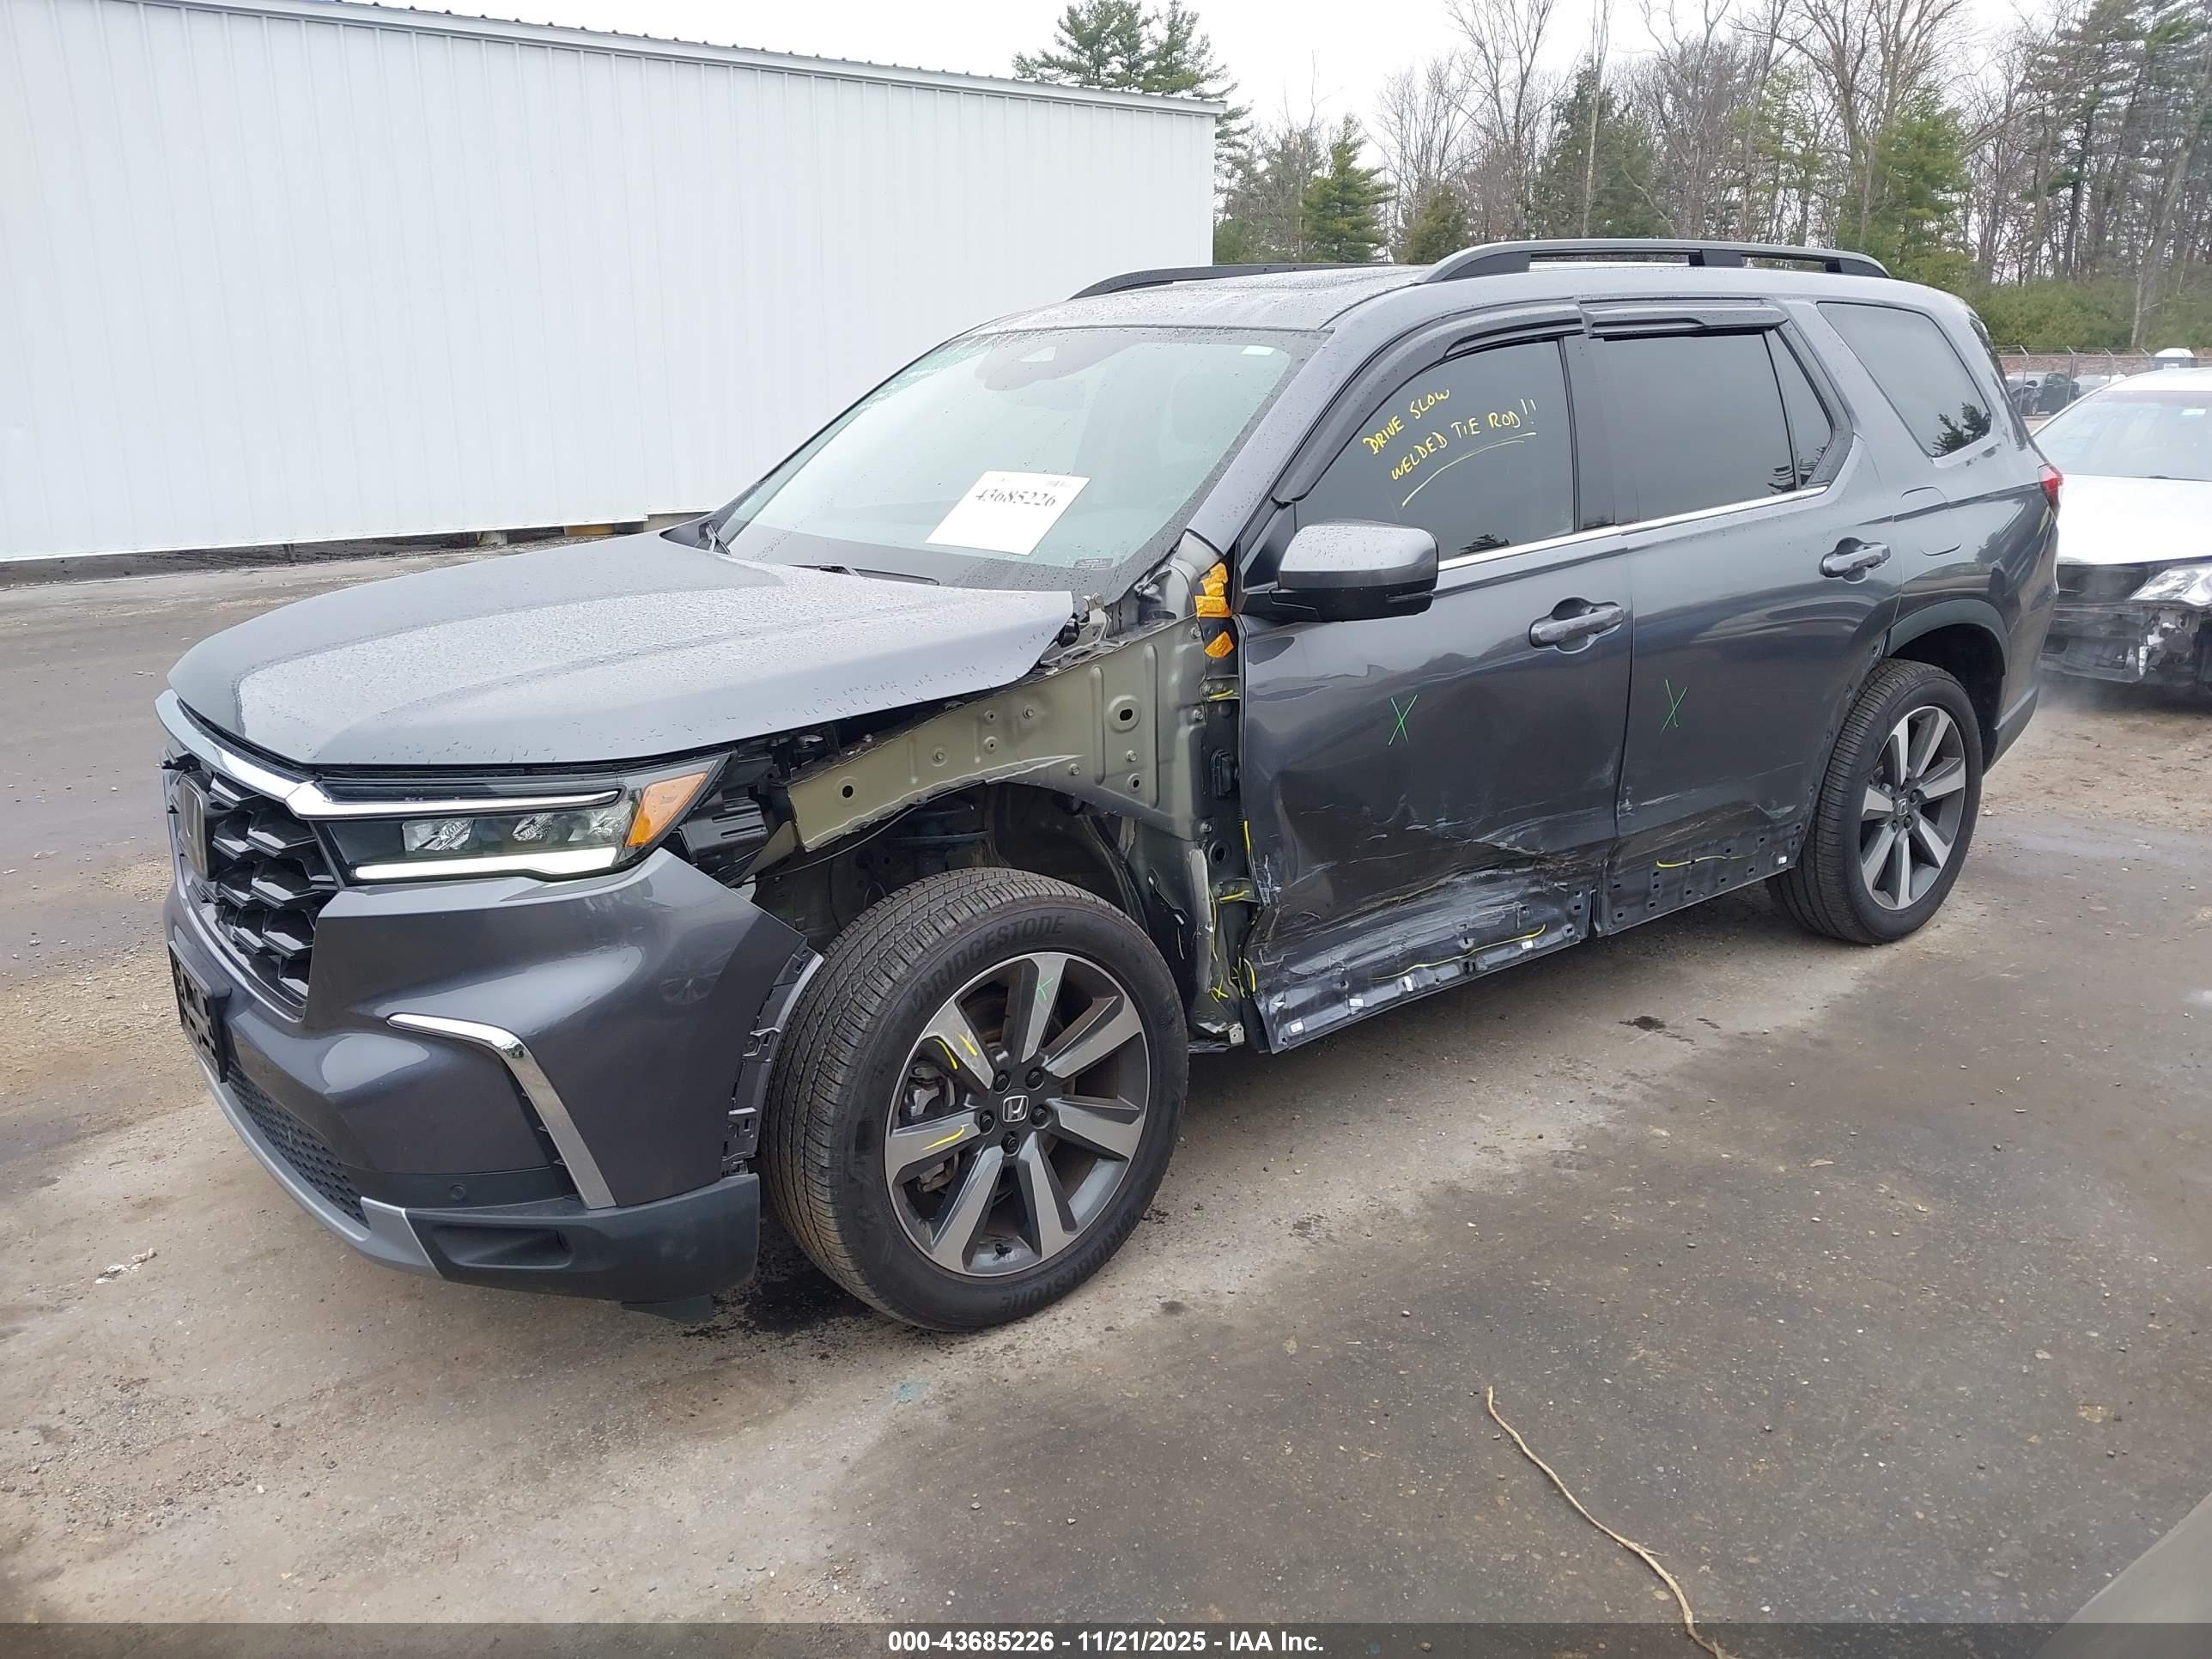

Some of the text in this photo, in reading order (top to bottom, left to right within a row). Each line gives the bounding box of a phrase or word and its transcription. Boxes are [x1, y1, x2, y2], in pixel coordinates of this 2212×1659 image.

[1362, 388, 1451, 456] DRIVE SLOW
[1390, 431, 1449, 482] WELDED
[1450, 417, 1482, 440] TIE
[975, 488, 1058, 507] 43685226
[912, 915, 1066, 1012] BRIDGESTONE
